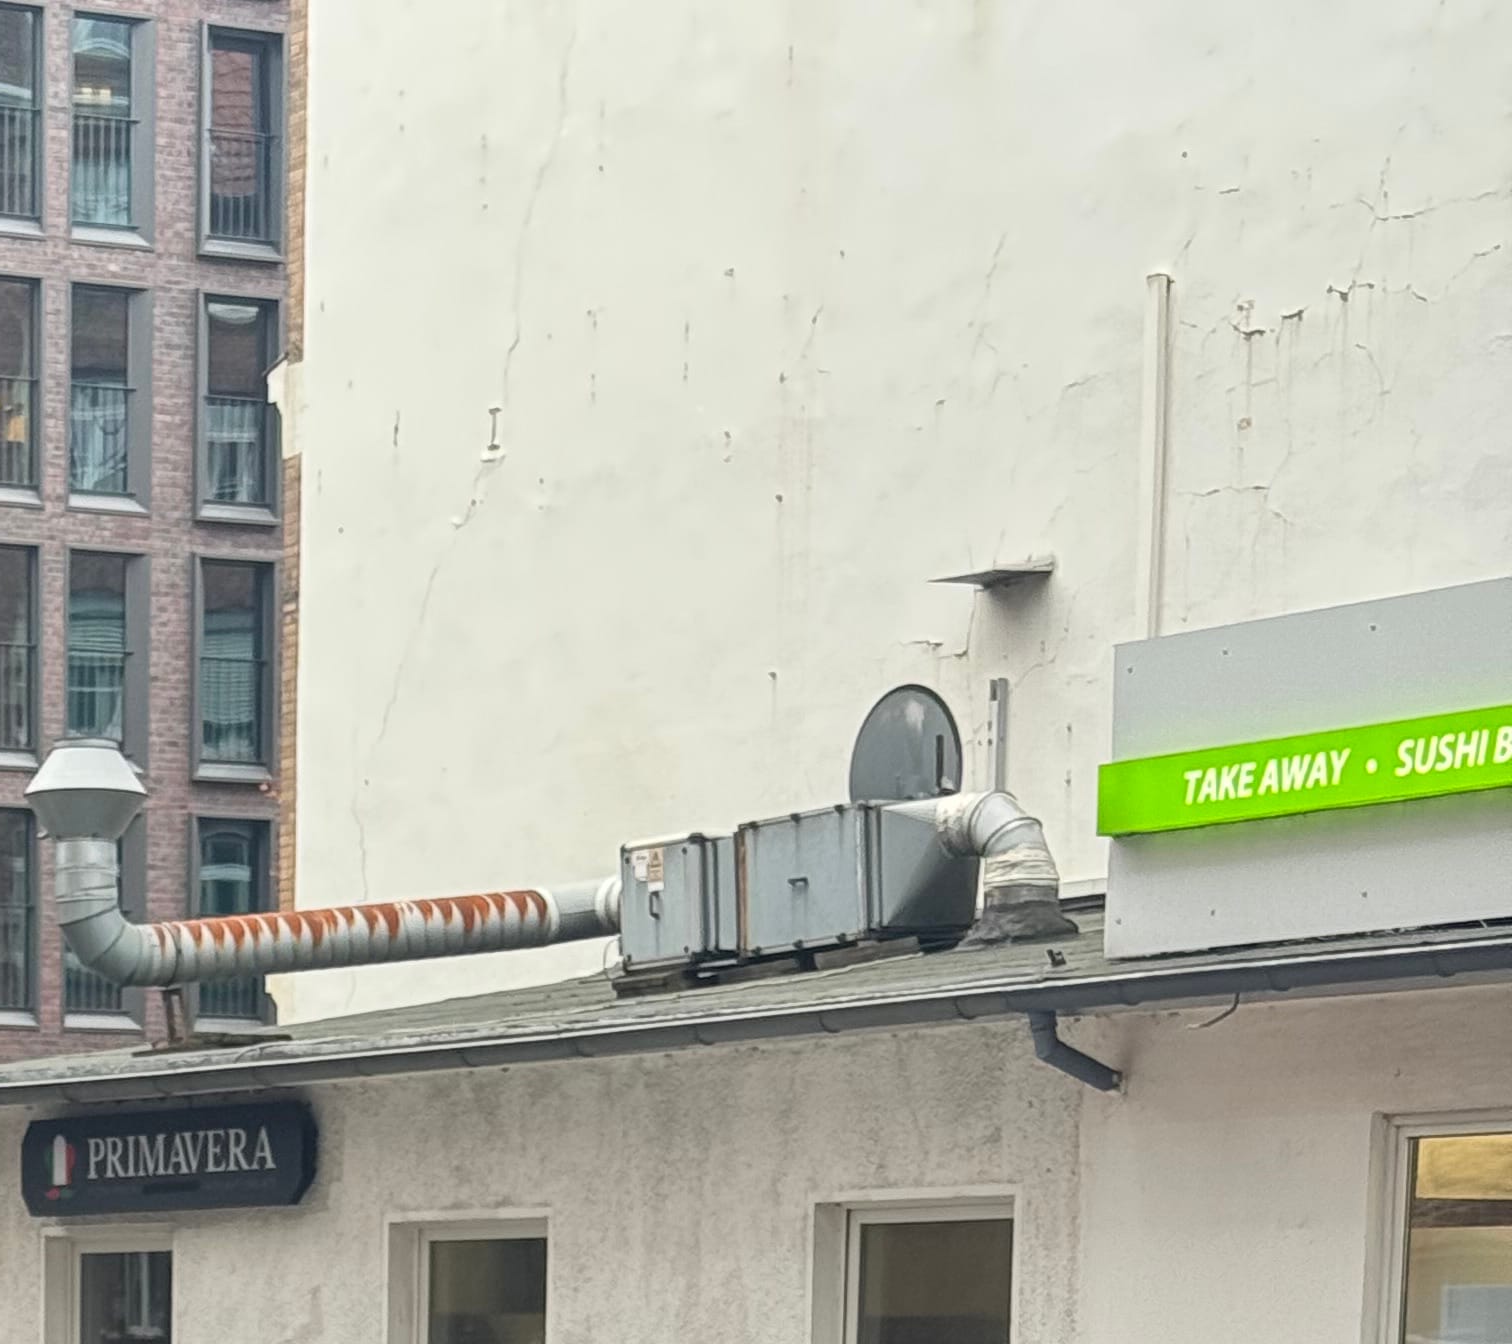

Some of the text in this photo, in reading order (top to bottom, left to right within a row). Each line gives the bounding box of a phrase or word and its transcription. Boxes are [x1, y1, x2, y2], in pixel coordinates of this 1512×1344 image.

[1183, 761, 1257, 805] TAKE
[1257, 748, 1352, 796] AWAY
[1394, 729, 1490, 777] SUSHI
[87, 1125, 277, 1180] PRIMAVERA
